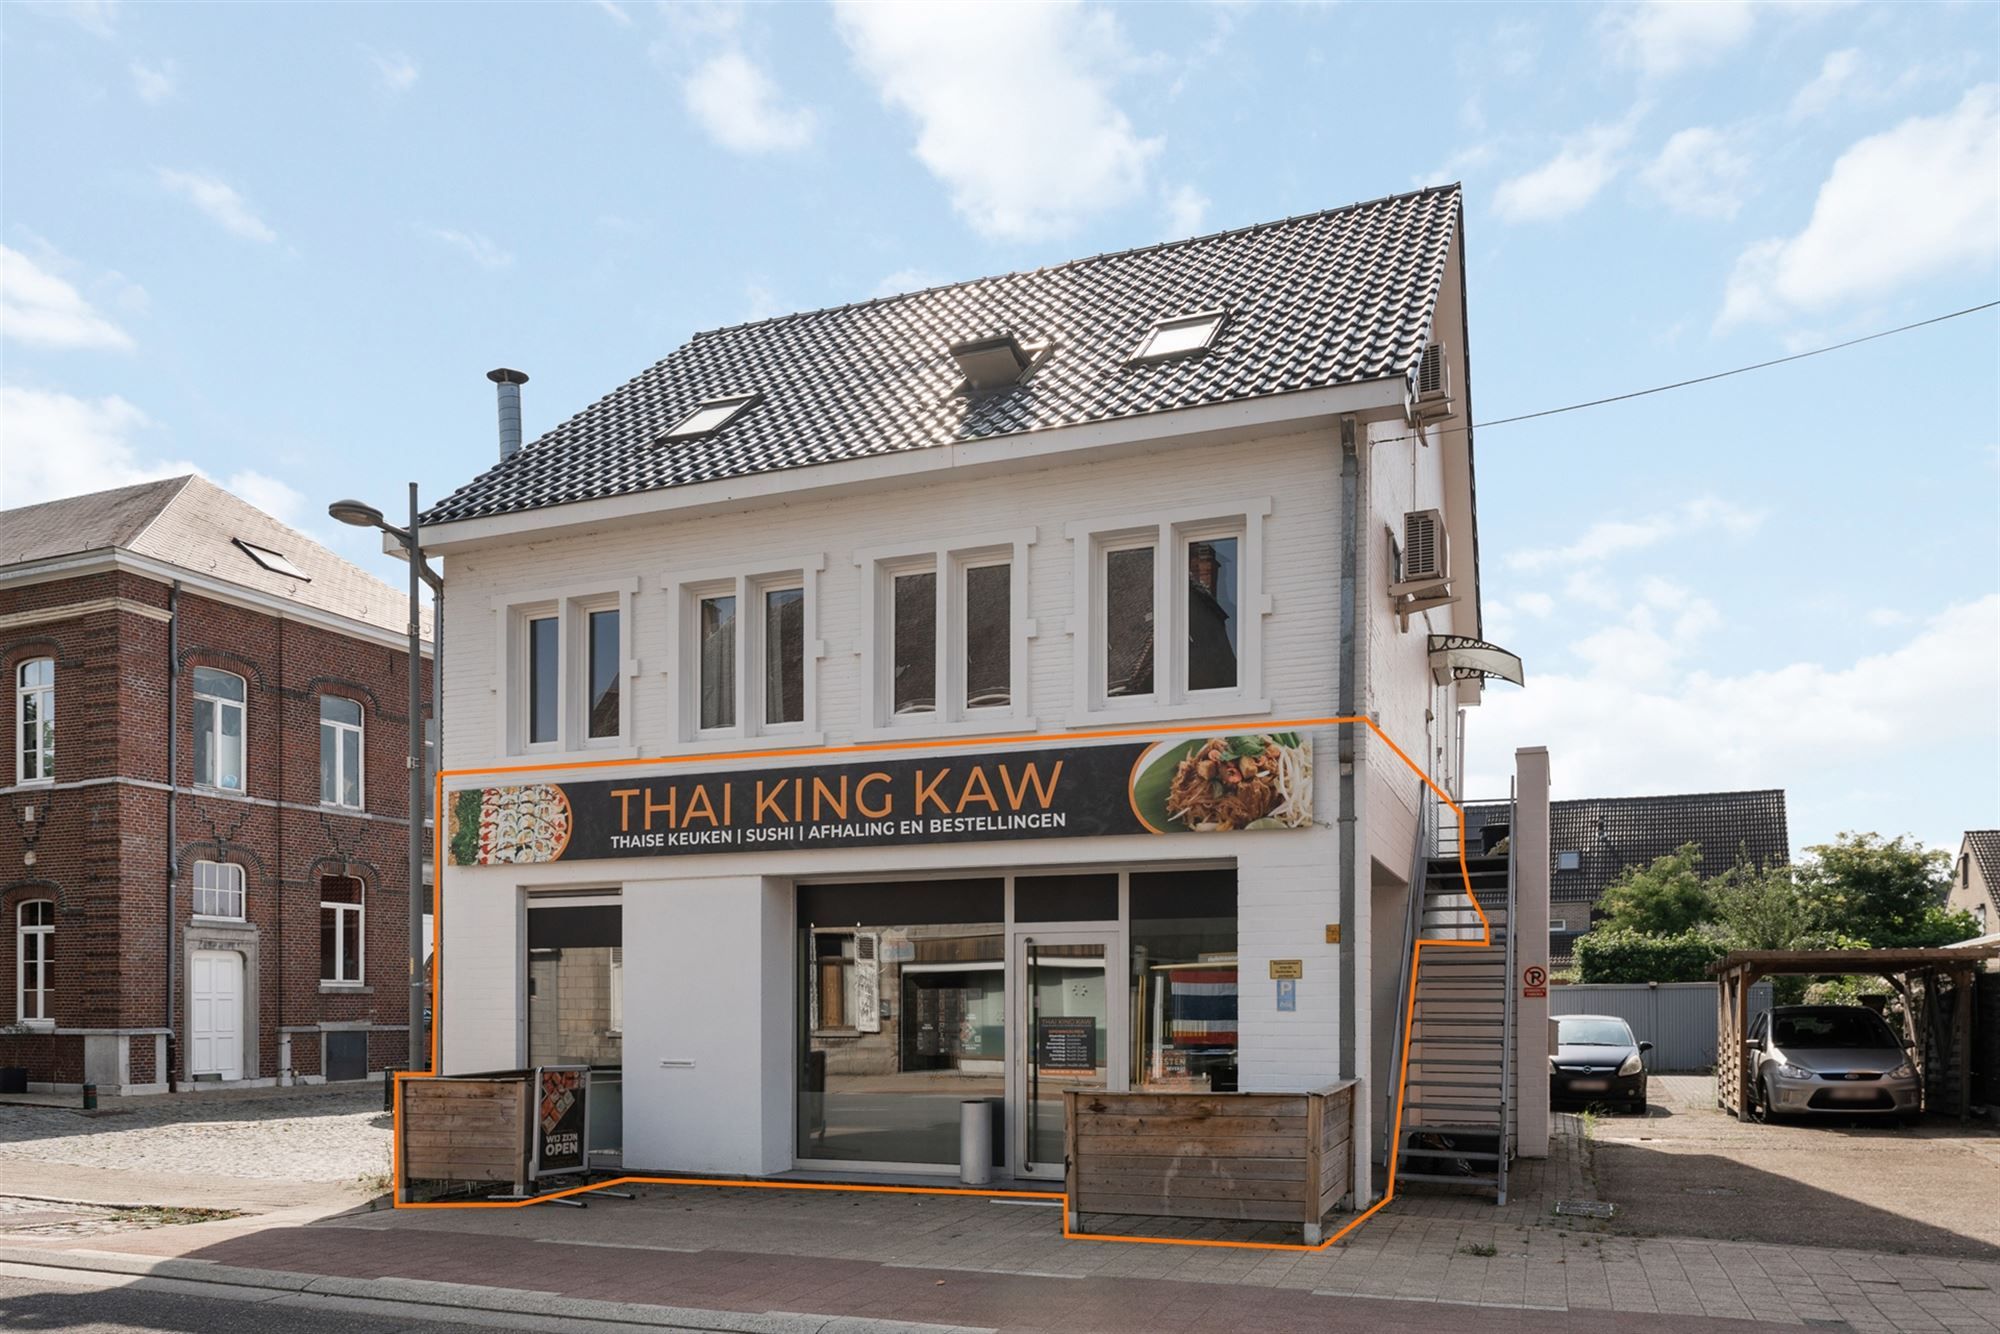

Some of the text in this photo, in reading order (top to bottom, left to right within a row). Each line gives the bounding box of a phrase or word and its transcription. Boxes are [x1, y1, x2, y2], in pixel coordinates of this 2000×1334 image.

[610, 760, 1064, 832] THAI KING KAW
[610, 833, 664, 849] THAISE
[668, 830, 732, 847] KEUKEN
[746, 827, 794, 842] SUSHI
[808, 821, 895, 839] AFHALING
[900, 820, 923, 835] EN
[930, 812, 1066, 833] BESTELLINGEN
[545, 1142, 578, 1156] OPEN
[546, 1133, 578, 1143] WIJ ZIJN
